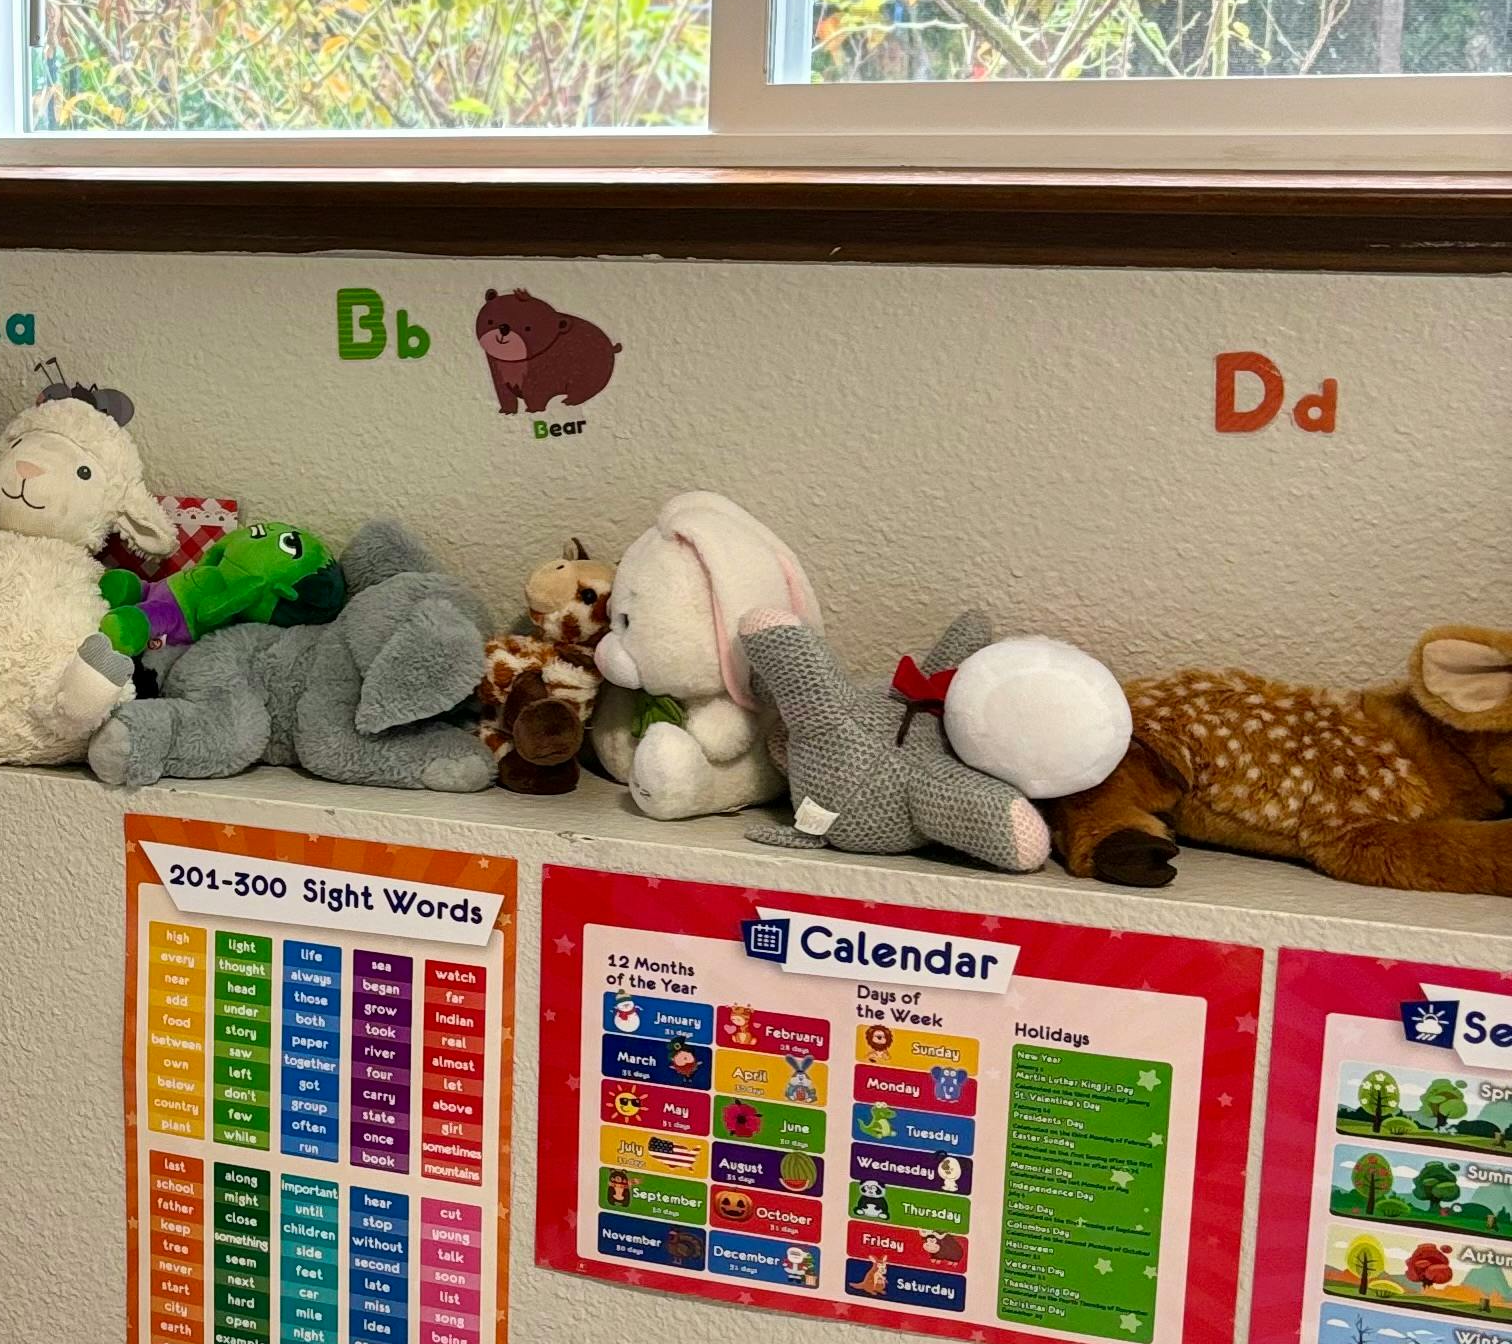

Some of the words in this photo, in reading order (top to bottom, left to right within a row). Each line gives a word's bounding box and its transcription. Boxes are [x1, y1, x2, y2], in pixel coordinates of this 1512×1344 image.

[534, 420, 586, 439] Bear
[170, 864, 287, 898] 201-300
[303, 878, 373, 912] Sight
[383, 888, 483, 924] Words
[166, 930, 189, 945] high
[228, 938, 256, 954] light
[801, 925, 998, 980] Calendar
[160, 951, 195, 968] every
[300, 948, 322, 962] life
[219, 958, 265, 976] thought
[371, 961, 391, 972] sea
[608, 954, 629, 968] 12
[634, 957, 695, 976] Months
[290, 970, 332, 986] always
[435, 970, 476, 983] watch
[606, 973, 624, 986] of
[629, 974, 656, 990] the
[661, 978, 698, 995] Year
[227, 981, 256, 996] head
[362, 978, 400, 995] began
[294, 991, 328, 1006] those
[445, 991, 464, 1004] far
[857, 985, 896, 1004] Days
[901, 992, 922, 1005] of
[224, 1004, 259, 1017] under
[364, 1003, 397, 1016] grow
[856, 1004, 885, 1020] the
[890, 1008, 943, 1027] Week
[162, 1014, 191, 1028] food
[295, 1012, 325, 1027] both
[435, 1011, 474, 1027] Indian
[654, 1012, 701, 1030] January
[225, 1024, 256, 1041] story
[365, 1022, 396, 1038] took
[765, 1026, 824, 1047] February
[1015, 1022, 1090, 1048] Holidays
[292, 1036, 328, 1049] paper
[441, 1036, 466, 1049] real
[229, 1047, 252, 1058] saw
[364, 1045, 396, 1059] river
[617, 1051, 657, 1067] March
[912, 1042, 960, 1061] Sunday
[284, 1053, 336, 1072] together
[432, 1055, 475, 1072] almost
[228, 1066, 252, 1080] left
[366, 1066, 393, 1080] four
[733, 1067, 768, 1083] April
[298, 1079, 320, 1091] got
[443, 1078, 463, 1091] let
[866, 1077, 920, 1098] Monday
[224, 1087, 256, 1102] don't
[362, 1090, 395, 1105] carry
[154, 1098, 199, 1116] country
[228, 1108, 252, 1122] few
[291, 1100, 327, 1115] group
[432, 1099, 472, 1115] above
[663, 1103, 689, 1119] May
[362, 1109, 395, 1124] state
[291, 1119, 326, 1134] often
[780, 1120, 810, 1134] June
[223, 1129, 256, 1144] while
[363, 1132, 394, 1145] once
[906, 1125, 959, 1145] Tuesday
[299, 1143, 318, 1155] run
[422, 1141, 482, 1160] sometimes
[618, 1141, 644, 1156] July
[164, 1158, 186, 1172] last
[362, 1151, 394, 1167] book
[719, 1158, 763, 1174] August
[857, 1156, 935, 1180] Wednesday
[156, 1178, 194, 1195] school
[225, 1170, 258, 1188] along
[281, 1179, 339, 1200] important
[632, 1187, 703, 1208] September
[157, 1197, 194, 1215] father
[224, 1191, 259, 1207] might
[364, 1194, 392, 1209] hear
[225, 1212, 257, 1226] close
[295, 1205, 324, 1218] until
[440, 1208, 462, 1220] cut
[756, 1207, 813, 1225] October
[902, 1203, 961, 1224] Thursday
[160, 1218, 190, 1237] keep
[283, 1223, 336, 1240] children
[362, 1216, 392, 1232] stop
[214, 1232, 269, 1253] something
[352, 1236, 403, 1253] without
[432, 1229, 470, 1246] young
[602, 1228, 662, 1247] November
[862, 1233, 904, 1253] Friday
[163, 1239, 188, 1254] tree
[296, 1245, 322, 1259] side
[225, 1254, 256, 1268] seem
[437, 1248, 464, 1263] talk
[713, 1246, 780, 1265] December
[159, 1260, 192, 1276] never
[295, 1264, 323, 1280] feet
[354, 1258, 400, 1274] second
[227, 1275, 255, 1288] next
[364, 1278, 390, 1292] late
[434, 1271, 465, 1284] soon
[161, 1280, 190, 1295] start
[299, 1288, 319, 1300] car
[897, 1278, 955, 1299] Saturday
[227, 1293, 254, 1308] hard
[439, 1290, 460, 1305] list
[164, 1301, 187, 1317] city
[296, 1308, 322, 1321] mile
[364, 1300, 390, 1313] miss
[160, 1321, 191, 1336] earth
[225, 1316, 256, 1329] open
[363, 1318, 390, 1334] idea
[434, 1313, 464, 1329] song
[293, 1327, 324, 1342] night
